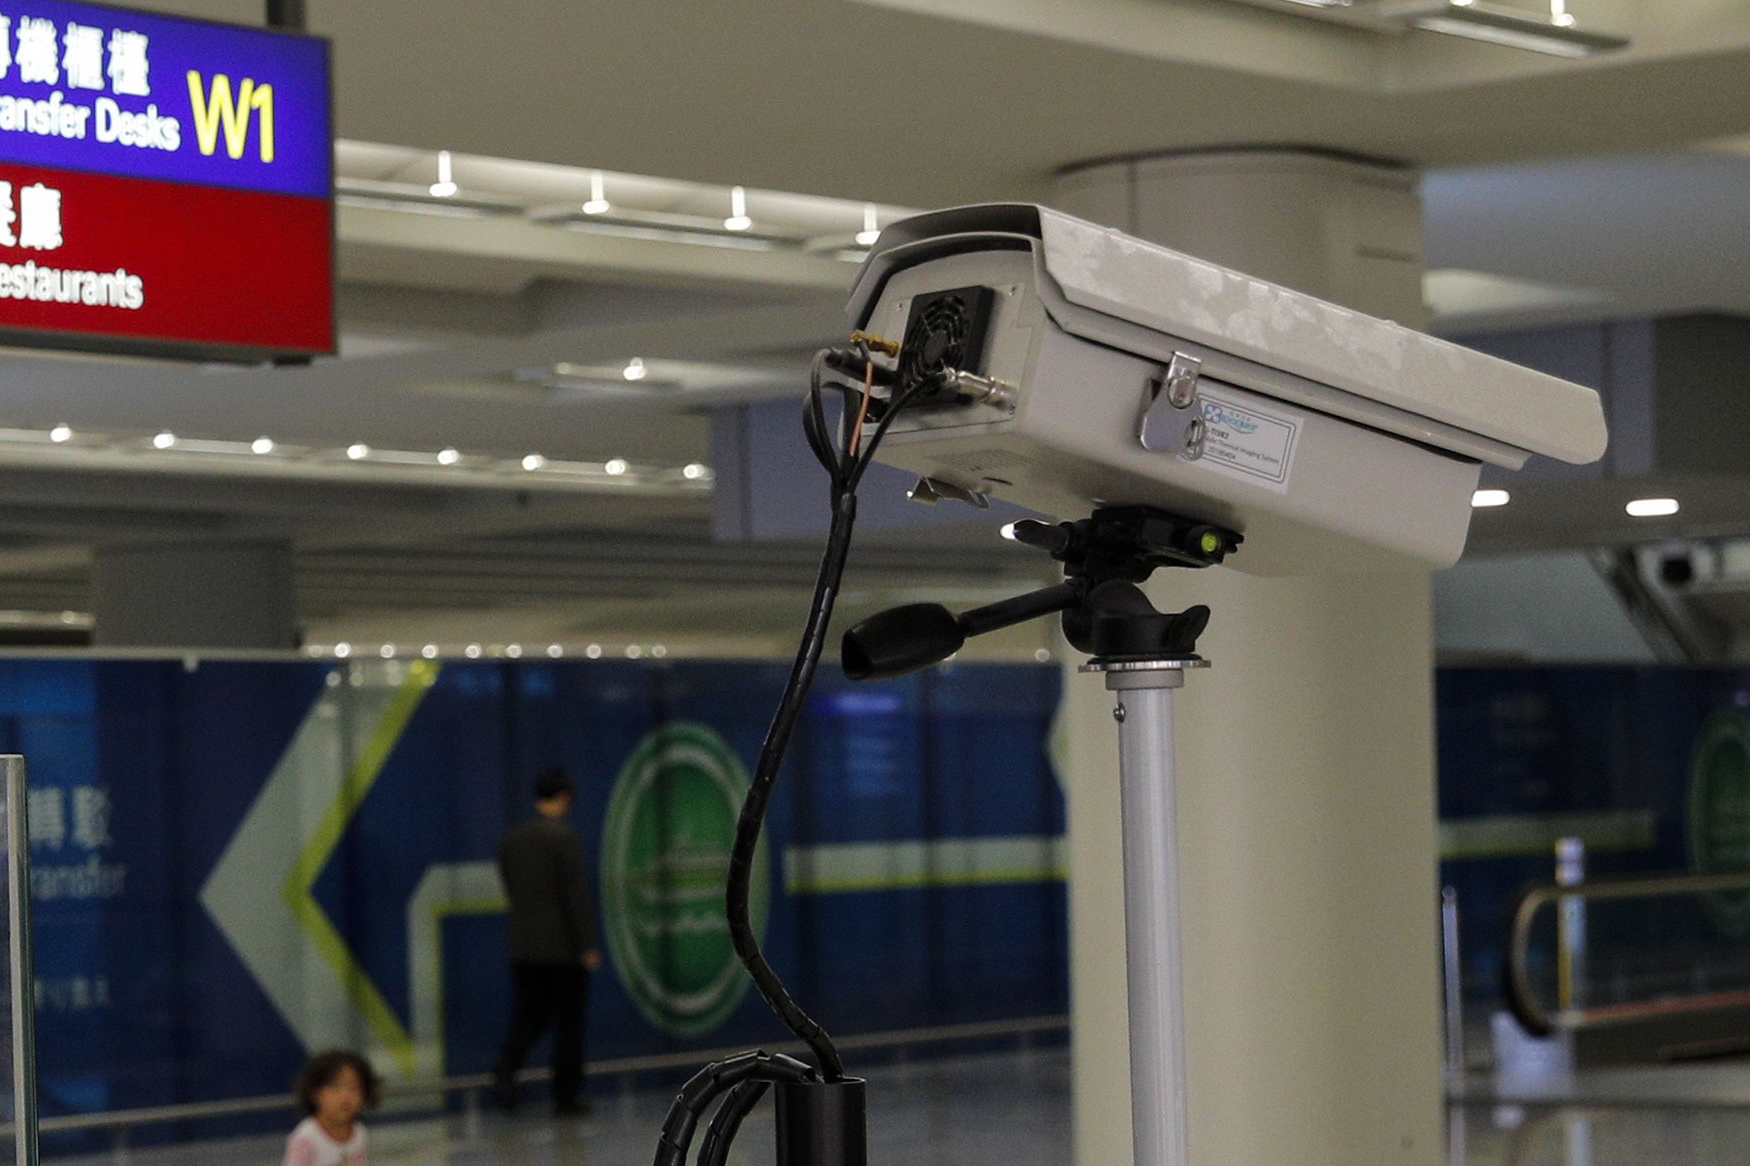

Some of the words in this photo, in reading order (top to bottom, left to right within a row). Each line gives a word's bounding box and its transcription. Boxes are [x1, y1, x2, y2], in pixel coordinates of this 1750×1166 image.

[94, 97, 182, 152] Desks
[186, 69, 274, 164] W1
[29, 852, 126, 900] ransfer
